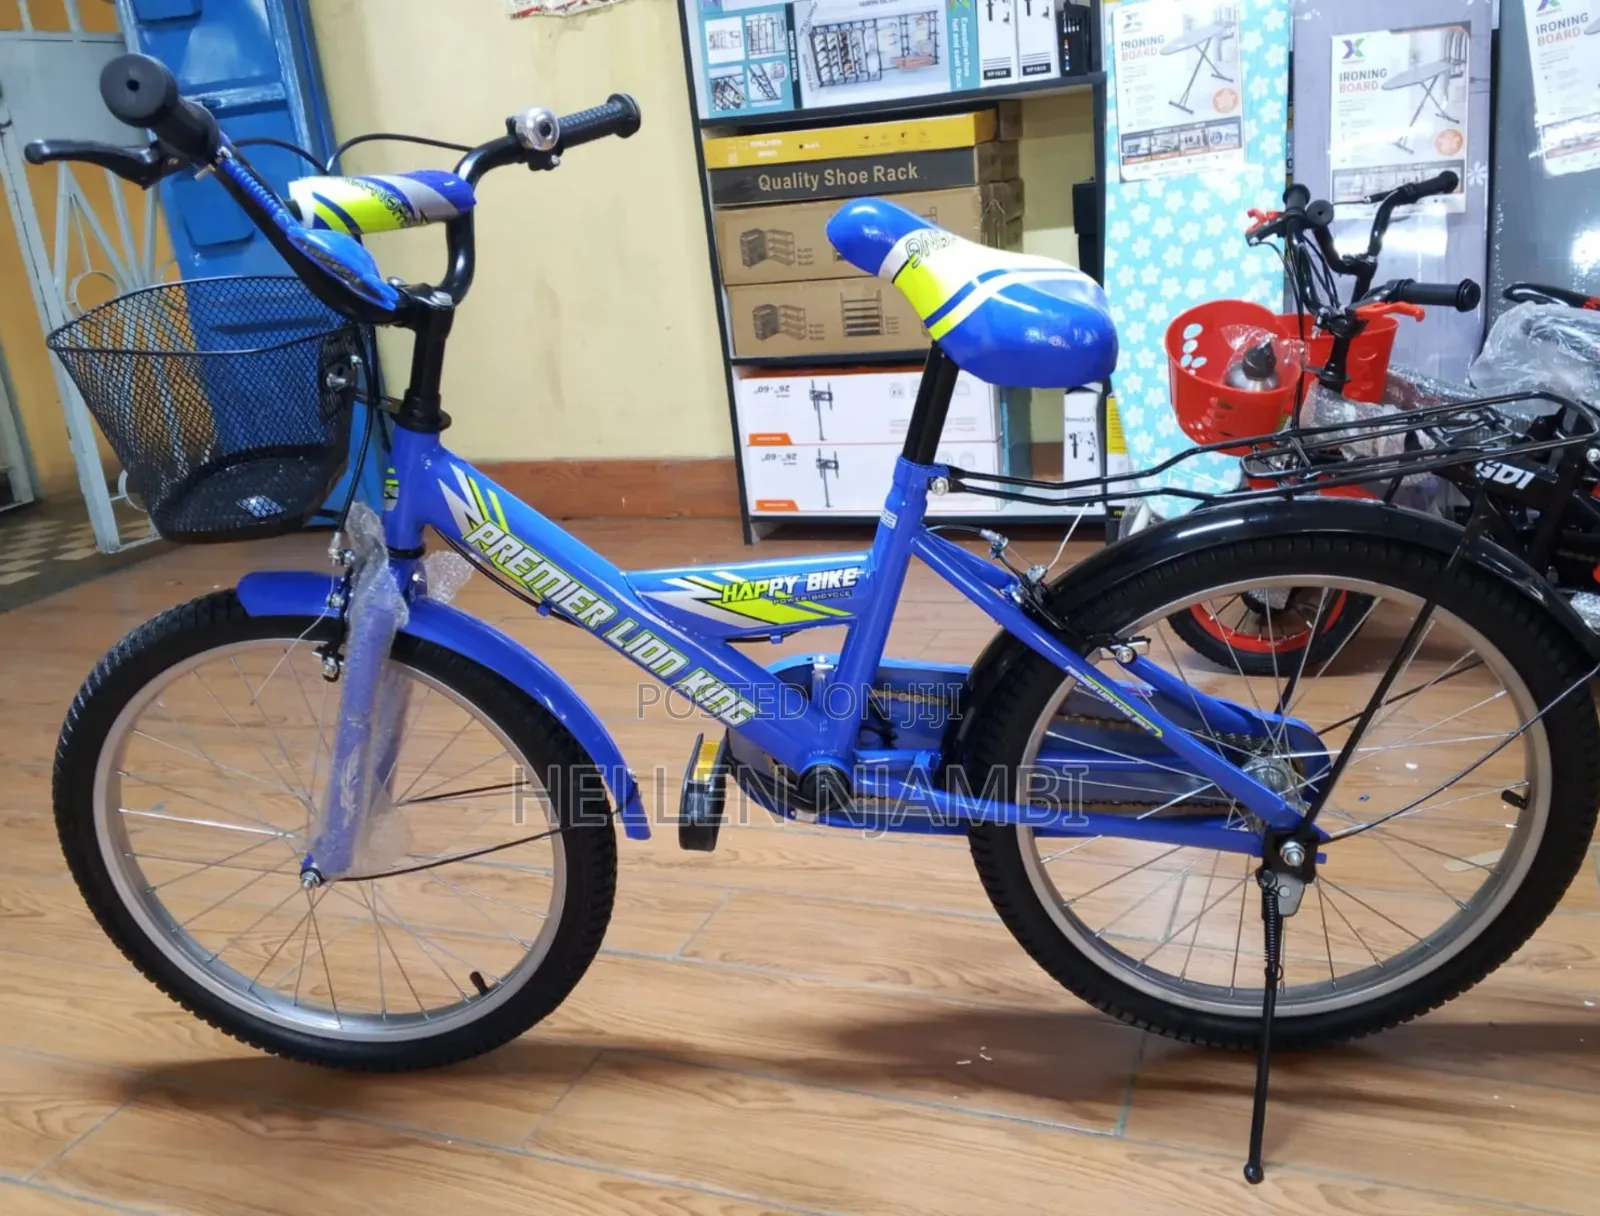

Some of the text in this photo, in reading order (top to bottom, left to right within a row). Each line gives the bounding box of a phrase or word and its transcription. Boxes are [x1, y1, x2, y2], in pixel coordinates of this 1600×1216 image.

[1536, 12, 1589, 35] IRONING
[1121, 35, 1165, 50] IRONING
[1537, 27, 1581, 46] BOARD
[1121, 48, 1158, 61] BOARD
[1339, 68, 1387, 82] IRONING
[1339, 80, 1379, 93] BOARD
[758, 162, 918, 192] Quality Shoe Rack
[722, 567, 860, 603] HAPPY BIKE
[811, 591, 851, 601] BICYCLE
[464, 520, 761, 727] PREMIER LION KING
